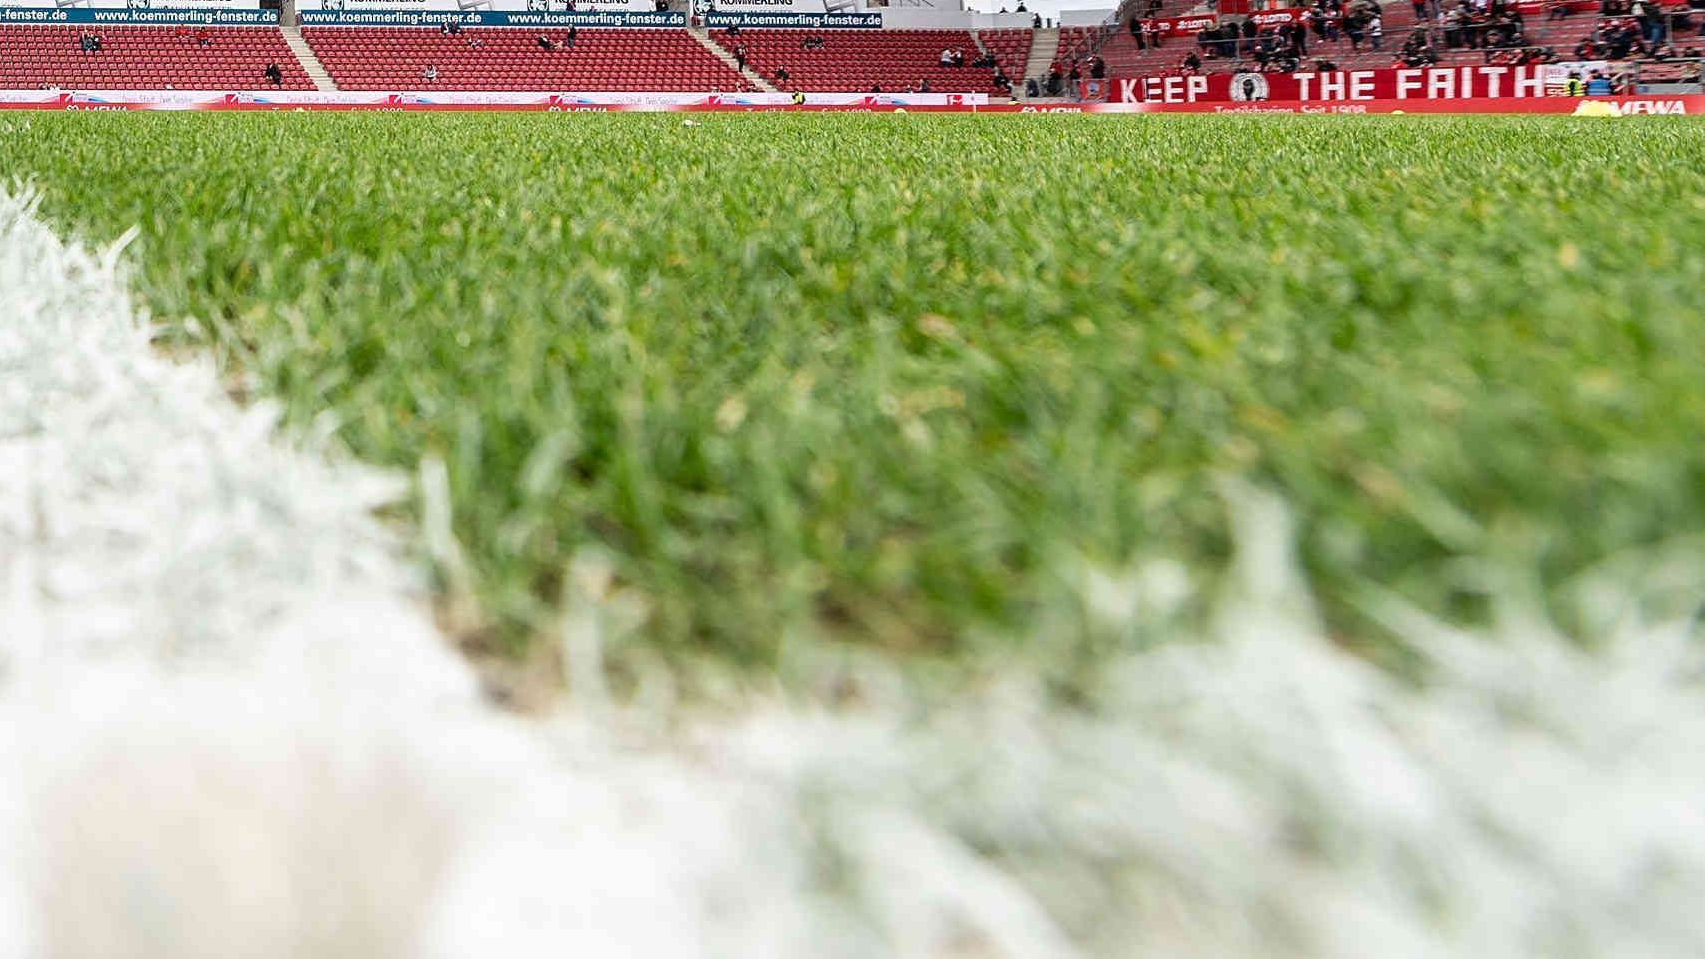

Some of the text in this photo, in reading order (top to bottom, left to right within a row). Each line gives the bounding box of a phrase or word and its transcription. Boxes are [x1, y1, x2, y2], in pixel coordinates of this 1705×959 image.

[94, 9, 277, 23] www.koemmerling-fenster.de
[302, 11, 482, 25] www.koemmerling-fenster.de
[508, 13, 685, 26] www.koemmerling-fenster.de
[708, 14, 882, 27] www.koemmerling-fenster.de
[1120, 64, 1543, 103] KEEP THE FAITH
